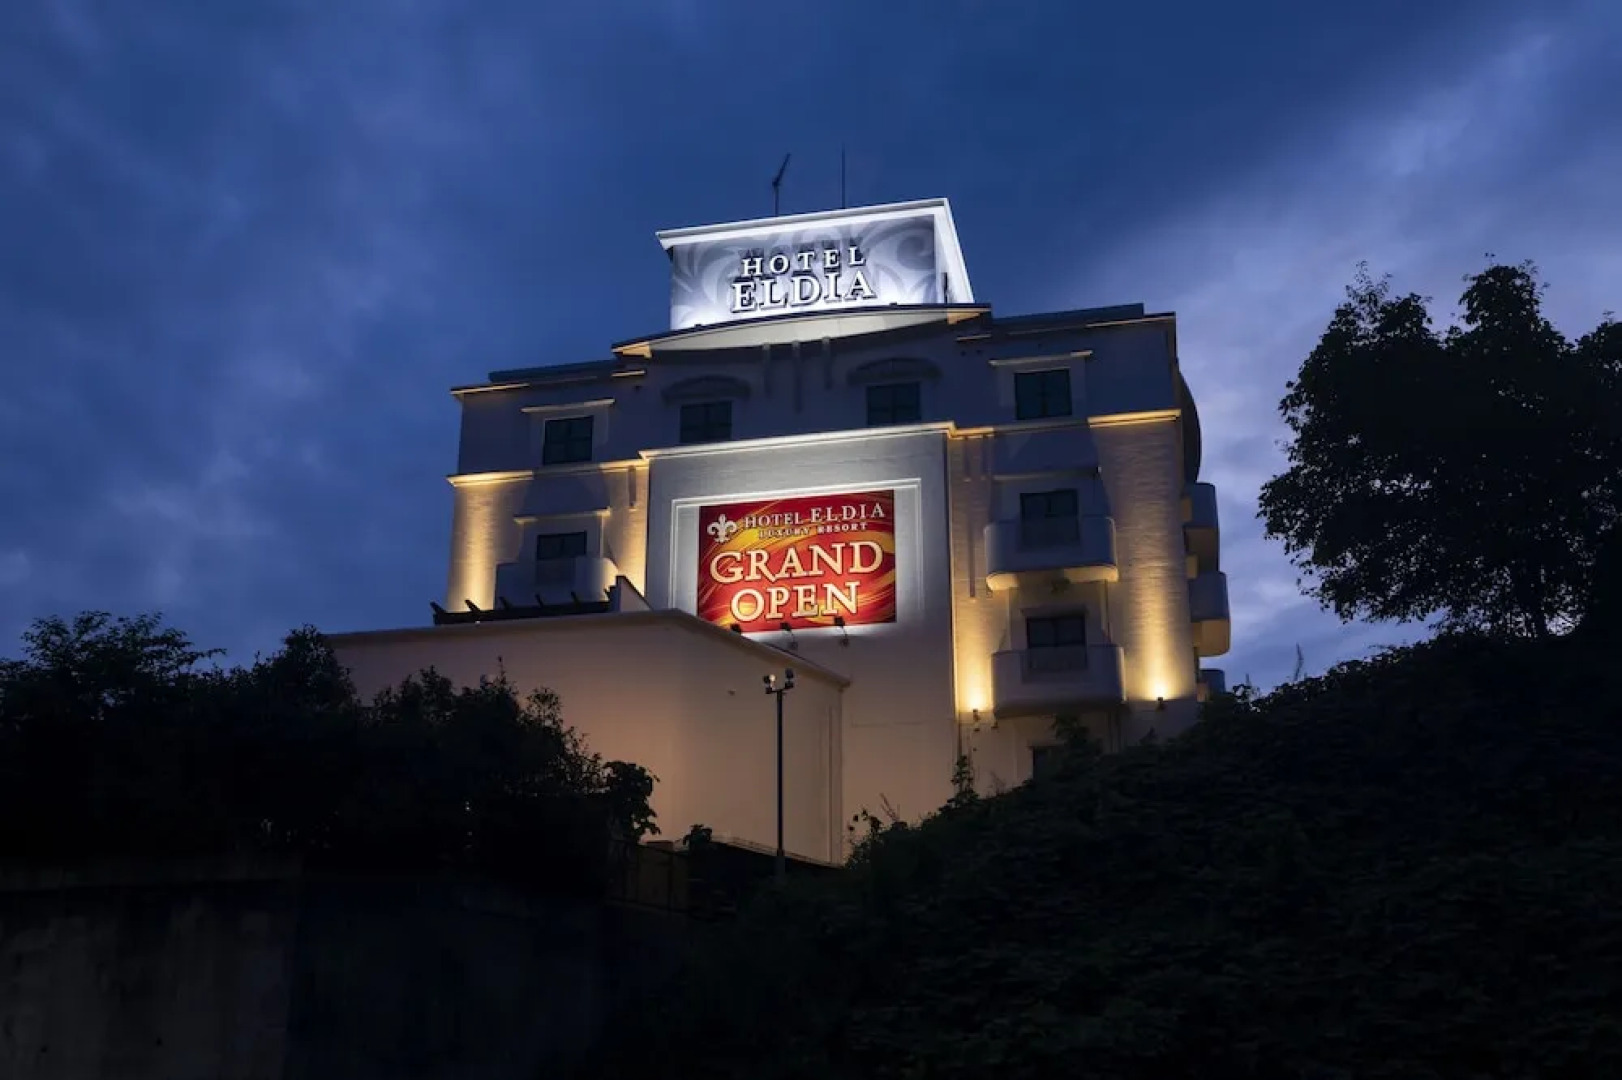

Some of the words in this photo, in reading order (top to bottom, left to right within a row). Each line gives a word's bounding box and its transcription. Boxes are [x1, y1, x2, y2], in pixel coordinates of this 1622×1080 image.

[741, 245, 866, 278] HOTEL
[731, 270, 877, 313] ELDIA
[745, 512, 804, 529] HOTEL
[811, 502, 886, 523] ELDIA
[758, 527, 810, 539] LUXURY
[818, 522, 868, 534] RESORT
[709, 541, 884, 585] GRAND
[730, 581, 861, 622] OPEN
